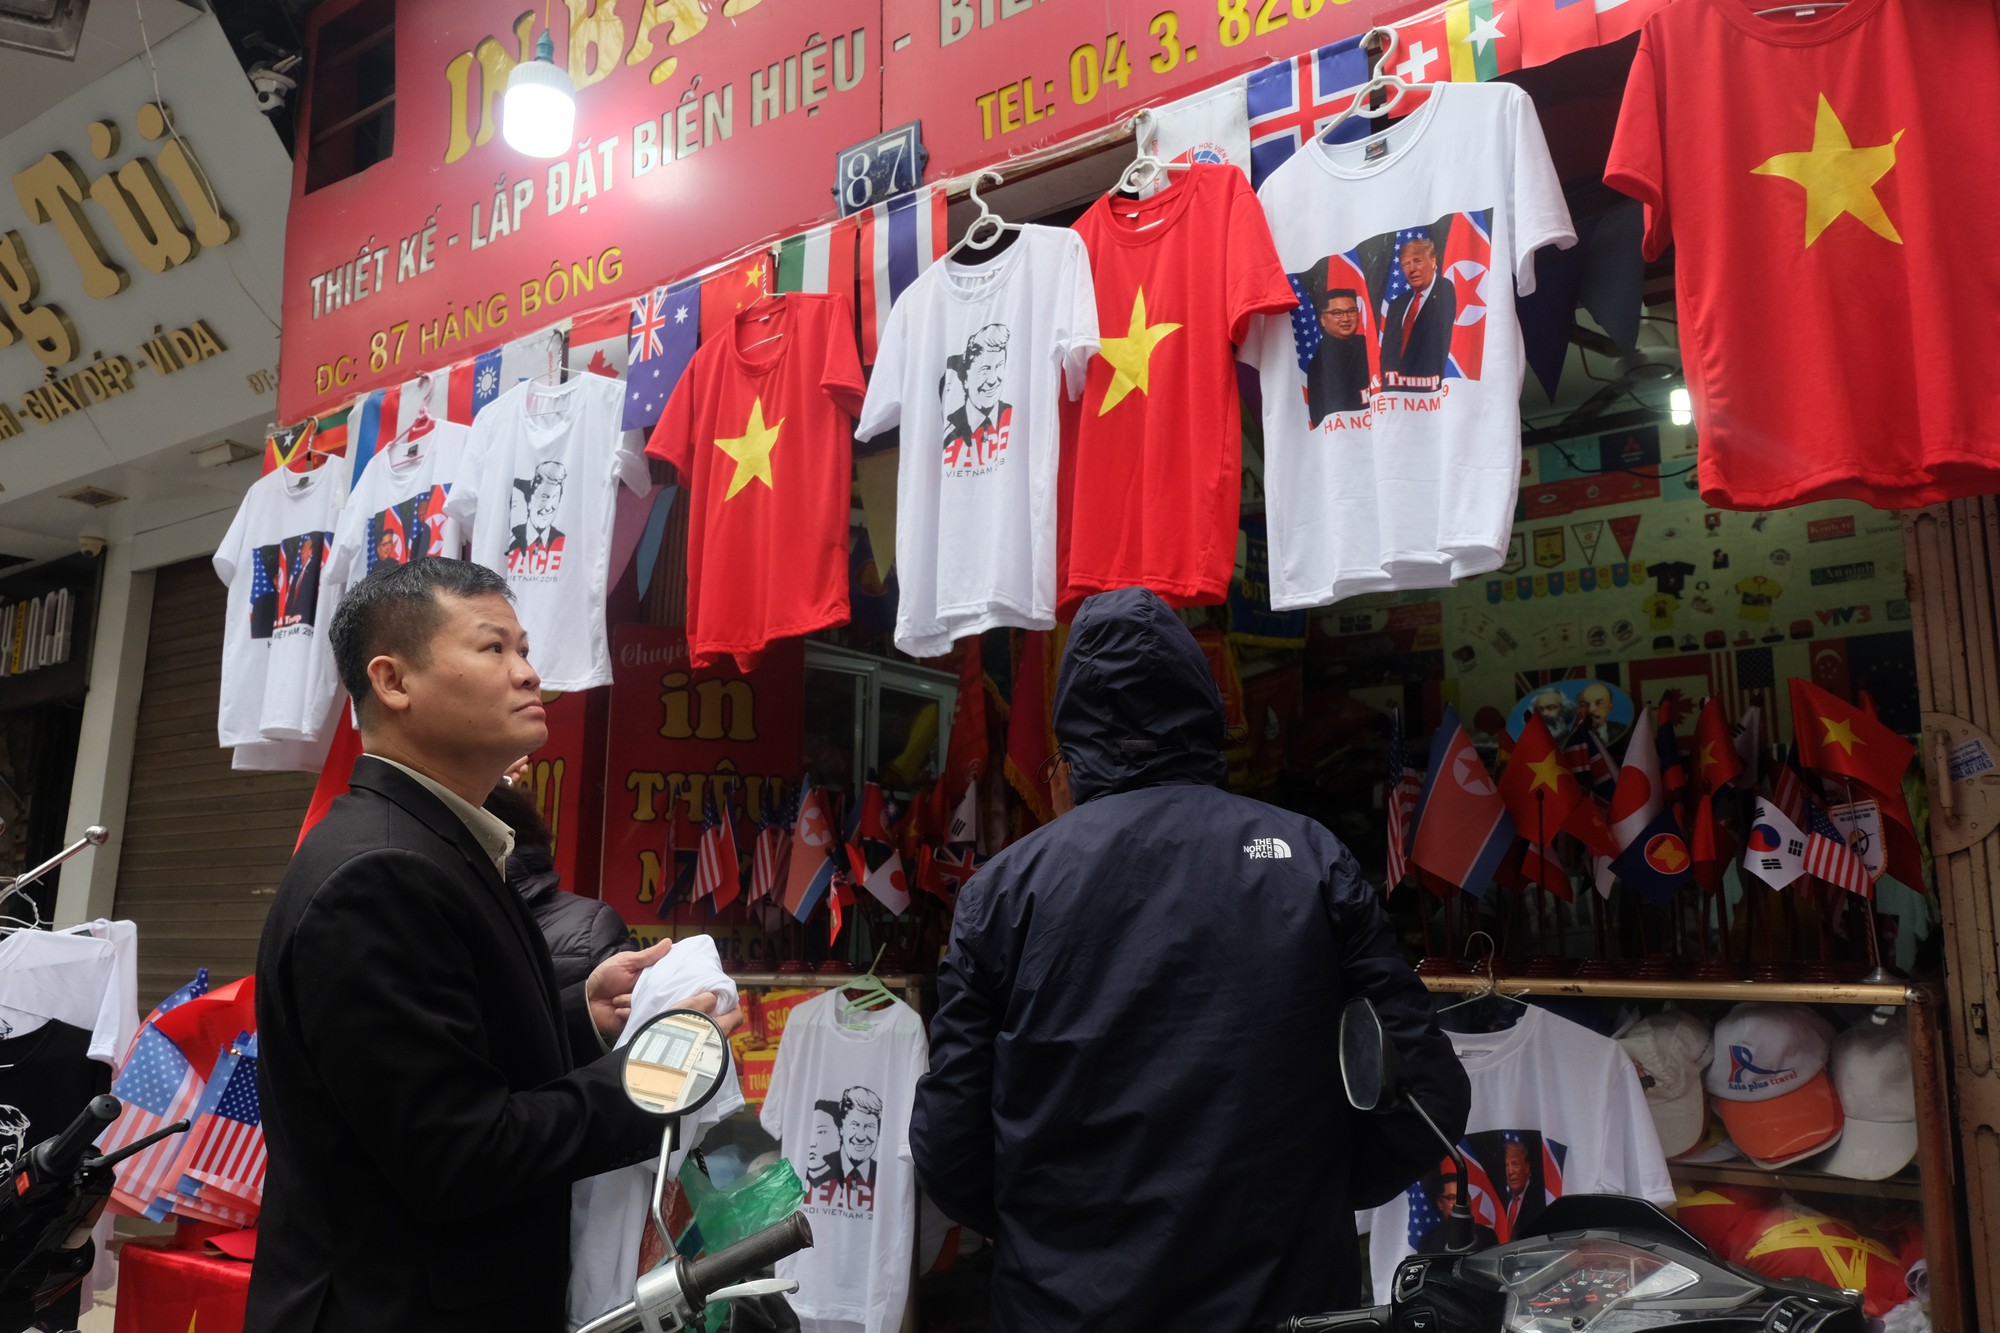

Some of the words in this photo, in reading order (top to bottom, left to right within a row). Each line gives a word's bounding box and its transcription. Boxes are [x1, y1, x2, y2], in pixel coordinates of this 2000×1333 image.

[976, 77, 1055, 141] TEL:
[1069, 33, 1132, 104] 04
[1149, 10, 1198, 74] 3.
[310, 235, 390, 319] THIẾT
[397, 204, 441, 284] KẾ
[470, 171, 534, 251] LẮP
[546, 136, 618, 215] ĐẶT
[632, 74, 733, 179] BIỂN
[750, 27, 866, 128] HIỆU
[846, 135, 908, 207] 87
[12, 101, 240, 300] Túi
[315, 355, 358, 395] ĐC:
[367, 320, 410, 374] 87
[419, 292, 509, 355] HÀNG
[520, 246, 624, 316] BÔNG
[168, 319, 228, 367] DA
[1385, 371, 1440, 391] Trump
[1324, 413, 1346, 434] HÀ
[1403, 397, 1441, 412] NAM
[946, 466, 993, 478] VIETNAM
[1814, 604, 1872, 626] VTV3
[658, 672, 758, 741] in
[1243, 844, 1273, 853] NORTH
[1249, 851, 1274, 860] FACE
[1253, 837, 1272, 846] THE
[1728, 1082, 1747, 1091] Asia
[1748, 1080, 1769, 1093] plus
[1770, 1070, 1798, 1086] travel
[822, 1207, 863, 1219] VIETNAM
